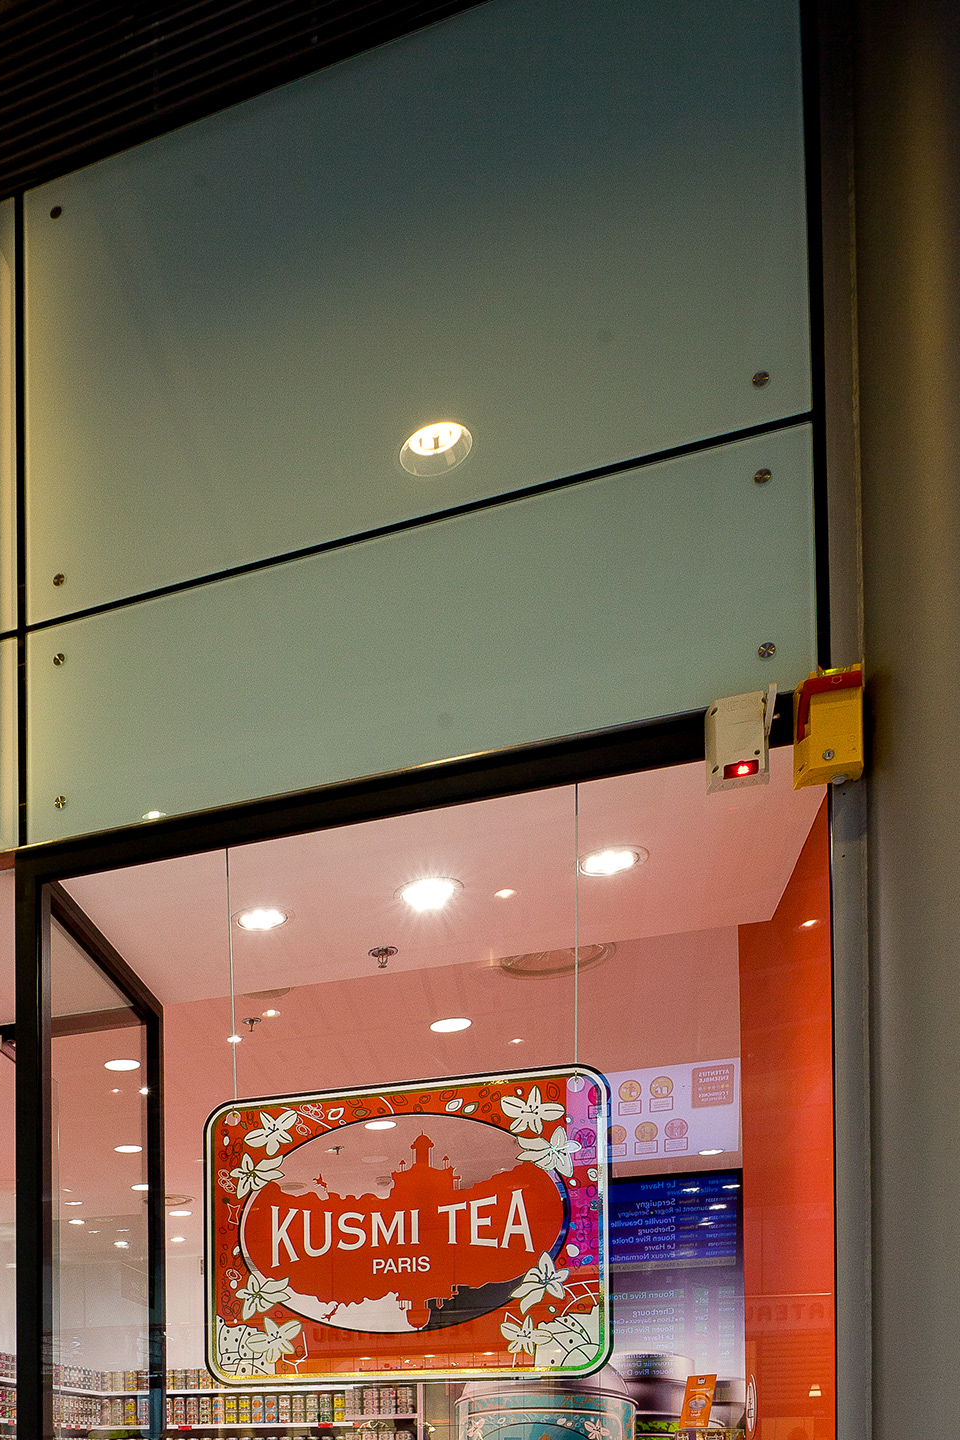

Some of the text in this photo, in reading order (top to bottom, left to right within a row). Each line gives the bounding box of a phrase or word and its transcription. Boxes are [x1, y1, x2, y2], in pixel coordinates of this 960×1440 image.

[270, 1188, 535, 1269] KUSMI TEA
[372, 1257, 431, 1274] PARIS
